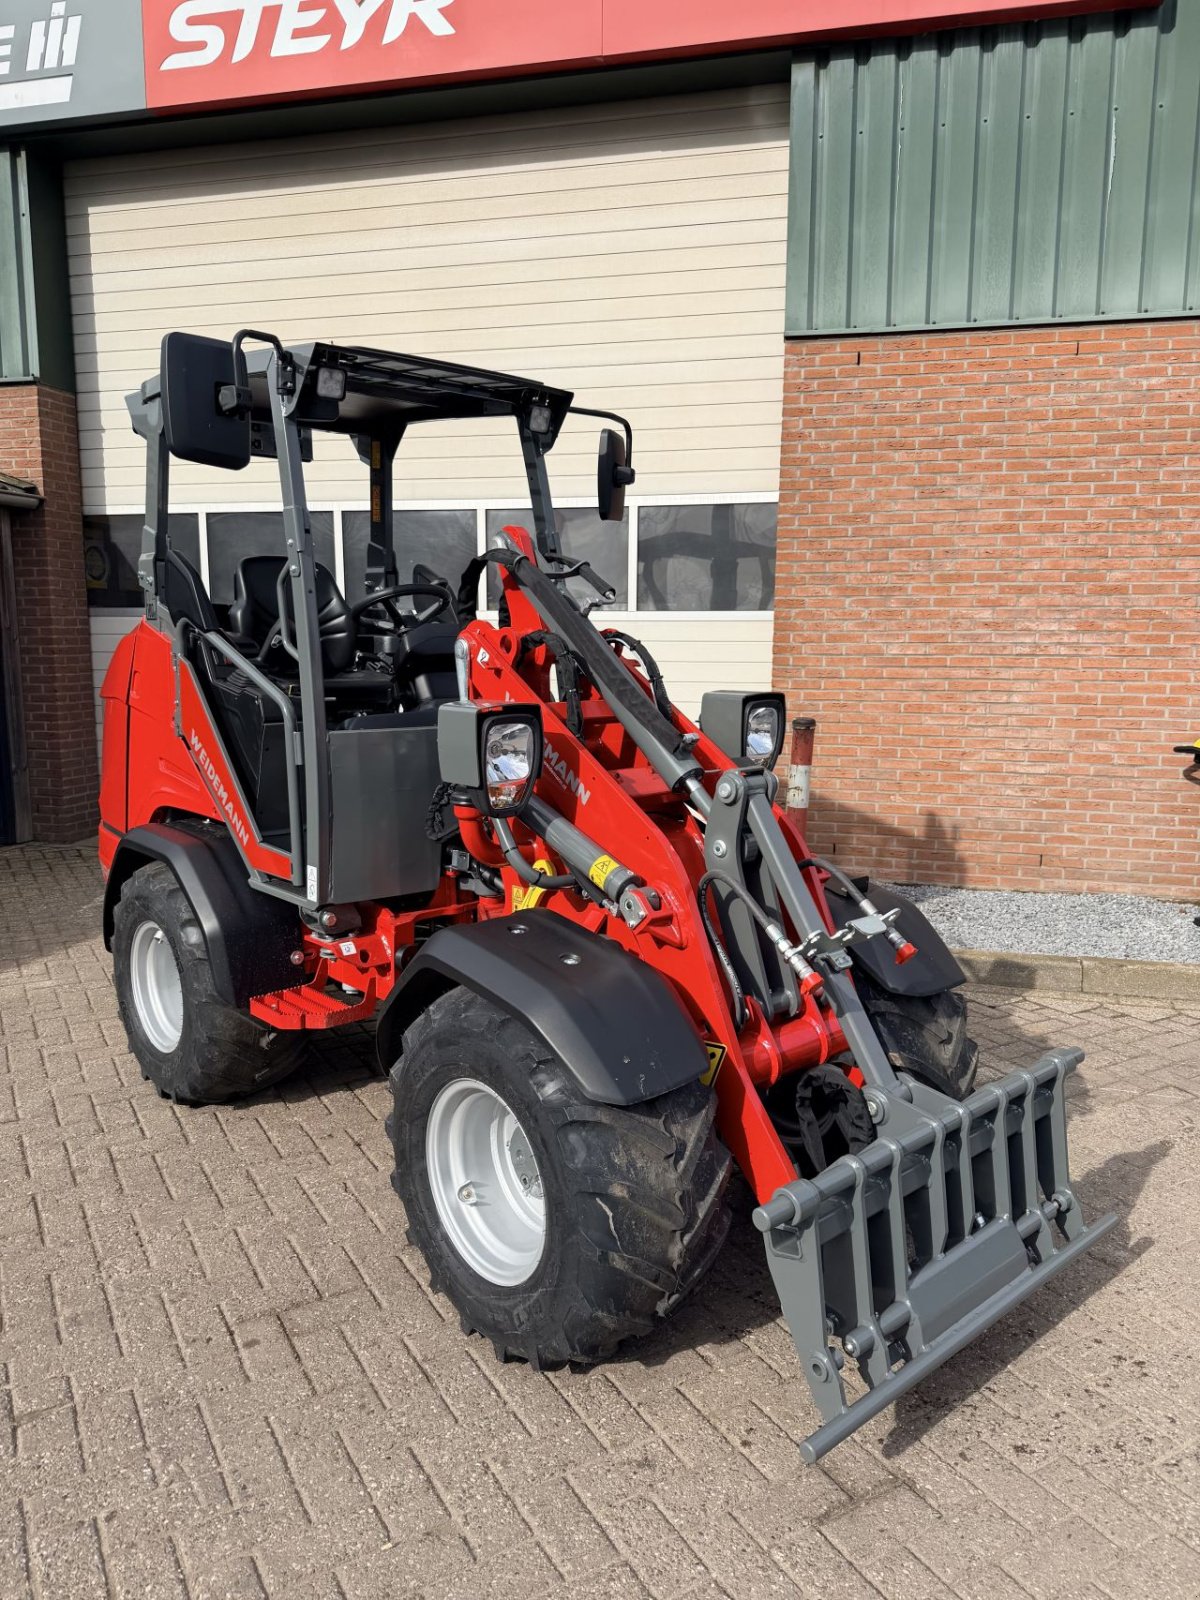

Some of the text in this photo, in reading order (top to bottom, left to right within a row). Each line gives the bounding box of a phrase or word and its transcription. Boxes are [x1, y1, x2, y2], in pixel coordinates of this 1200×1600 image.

[159, 0, 457, 71] STEYR
[190, 728, 249, 846] WEIDEMANN
[544, 736, 591, 806] MANN
